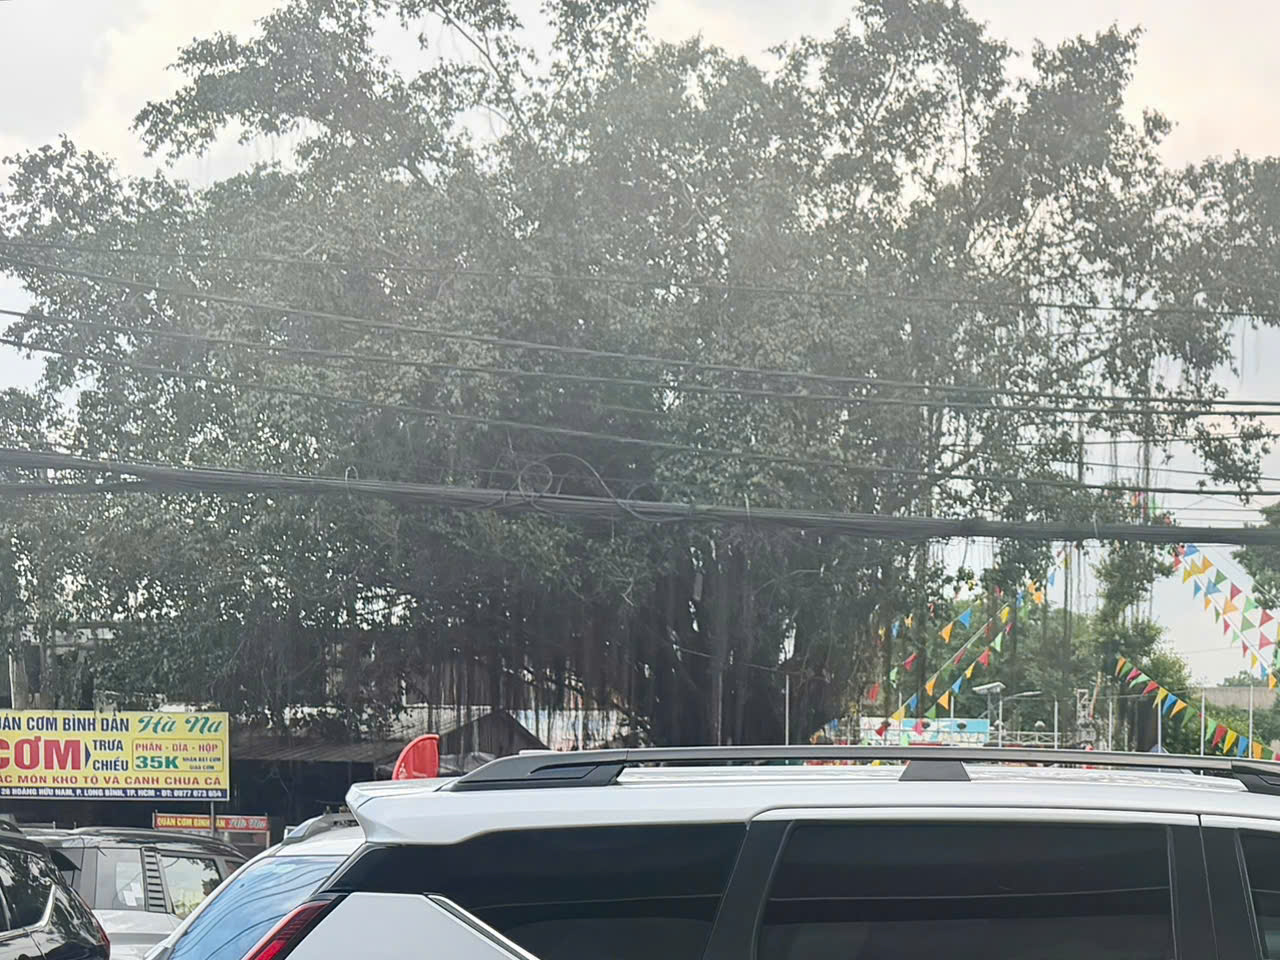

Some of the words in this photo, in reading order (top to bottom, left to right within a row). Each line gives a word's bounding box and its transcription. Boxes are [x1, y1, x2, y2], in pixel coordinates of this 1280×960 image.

[26, 715, 58, 731] CƠM
[63, 714, 96, 732] BÌNH
[137, 716, 176, 734] Hà
[92, 739, 124, 751] TRƯA
[135, 755, 179, 769] 35K
[52, 775, 78, 784] KHO
[125, 776, 160, 785] CANH
[165, 776, 199, 785] CHUA
